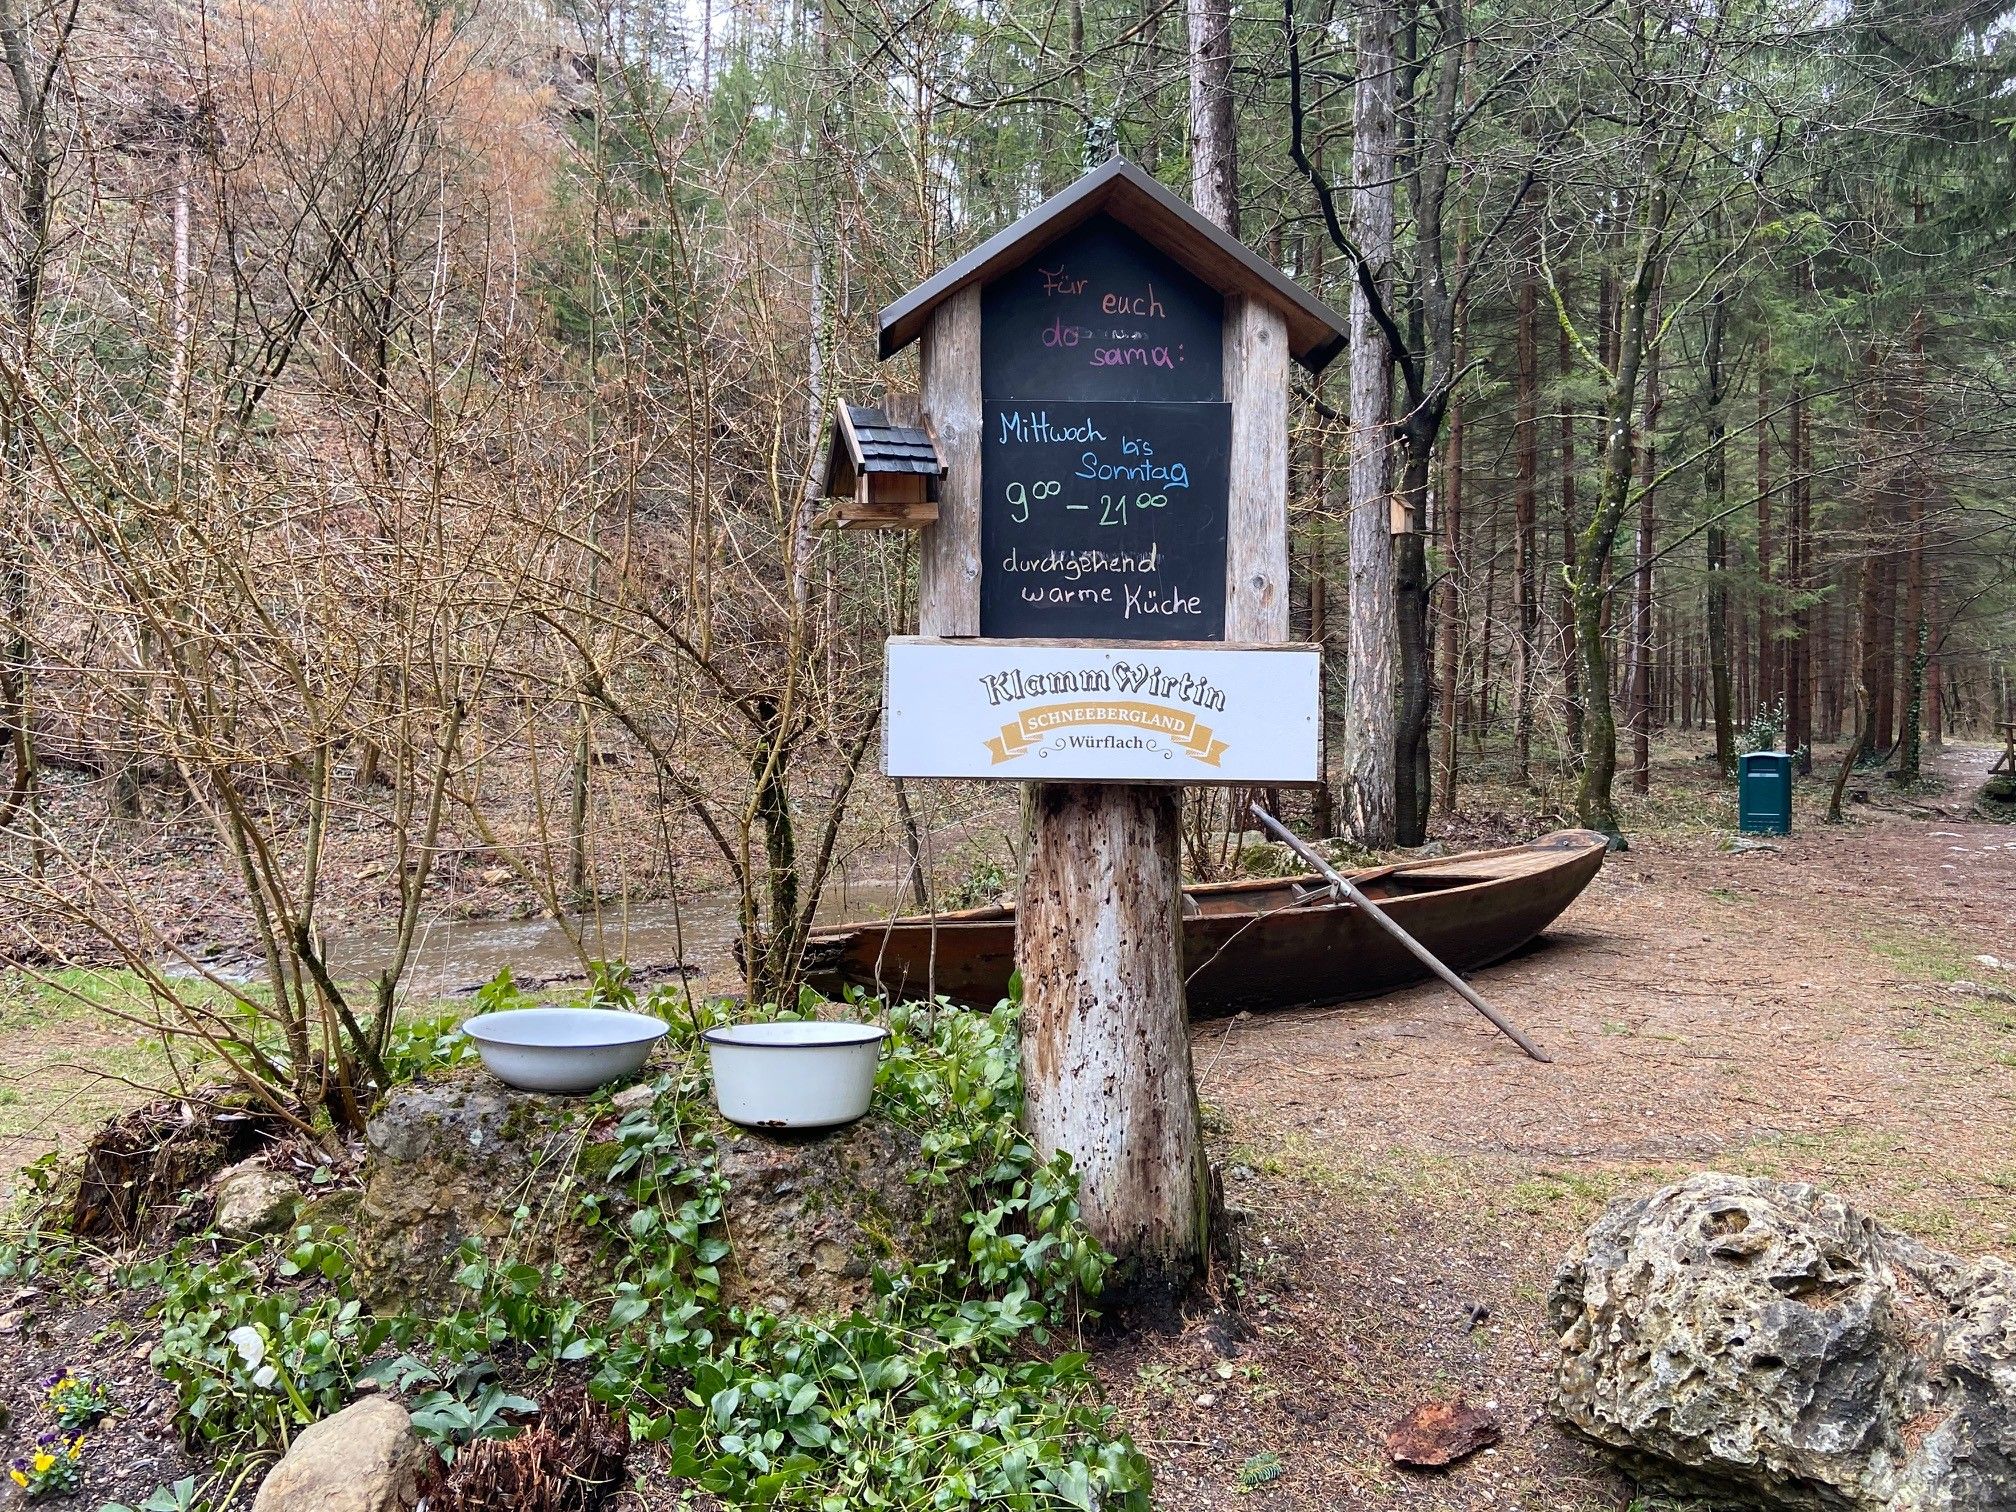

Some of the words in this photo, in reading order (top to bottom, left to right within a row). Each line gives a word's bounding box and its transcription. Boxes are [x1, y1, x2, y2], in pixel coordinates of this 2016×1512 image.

[1039, 264, 1088, 297] Für
[1102, 284, 1166, 319] euch
[1089, 344, 1185, 370] sama:
[1000, 411, 1107, 445] Mittwoch
[1122, 436, 1154, 456] bis
[1075, 452, 1190, 490] Sonntag
[1002, 542, 1158, 580] durchgehend
[1021, 586, 1113, 603] warme
[1124, 583, 1202, 620] Küche
[1028, 708, 1186, 732] SCHNEEBERGLAND
[1069, 735, 1143, 750] Würflach
